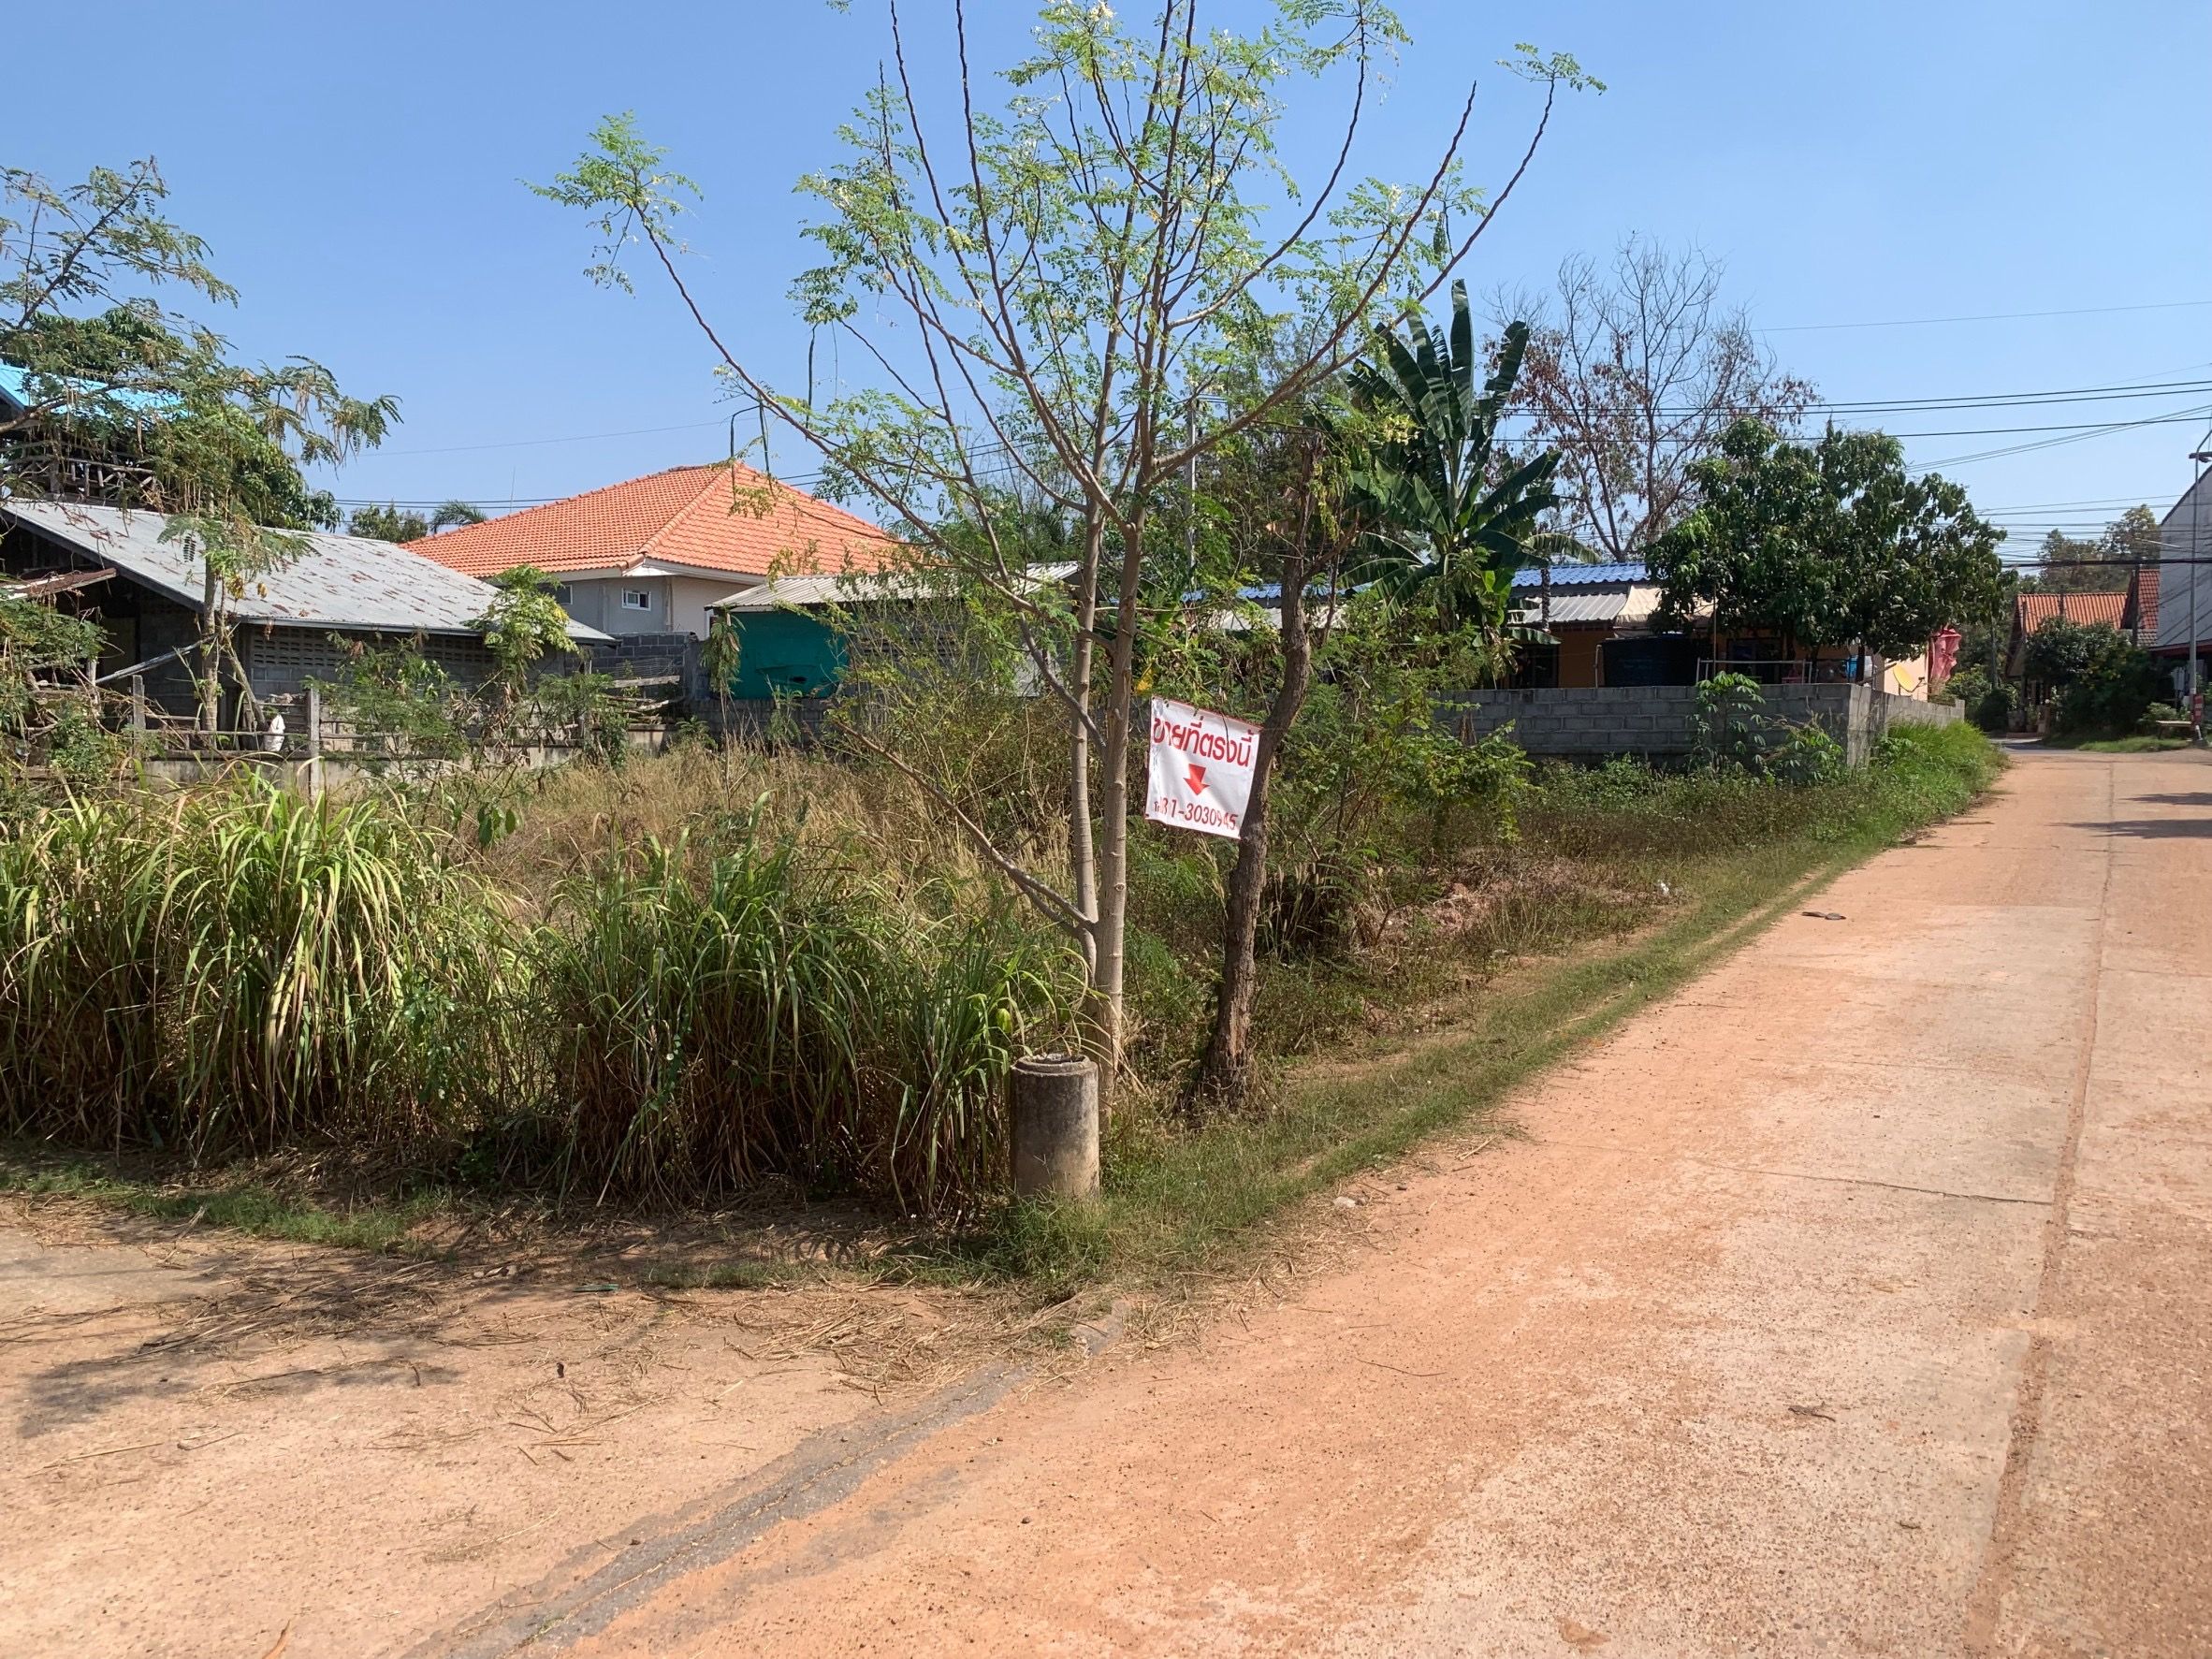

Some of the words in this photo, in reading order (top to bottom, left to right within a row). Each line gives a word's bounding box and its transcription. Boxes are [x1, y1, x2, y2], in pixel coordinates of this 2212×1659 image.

[1153, 716, 1254, 767] ขายที่ตรงนี้
